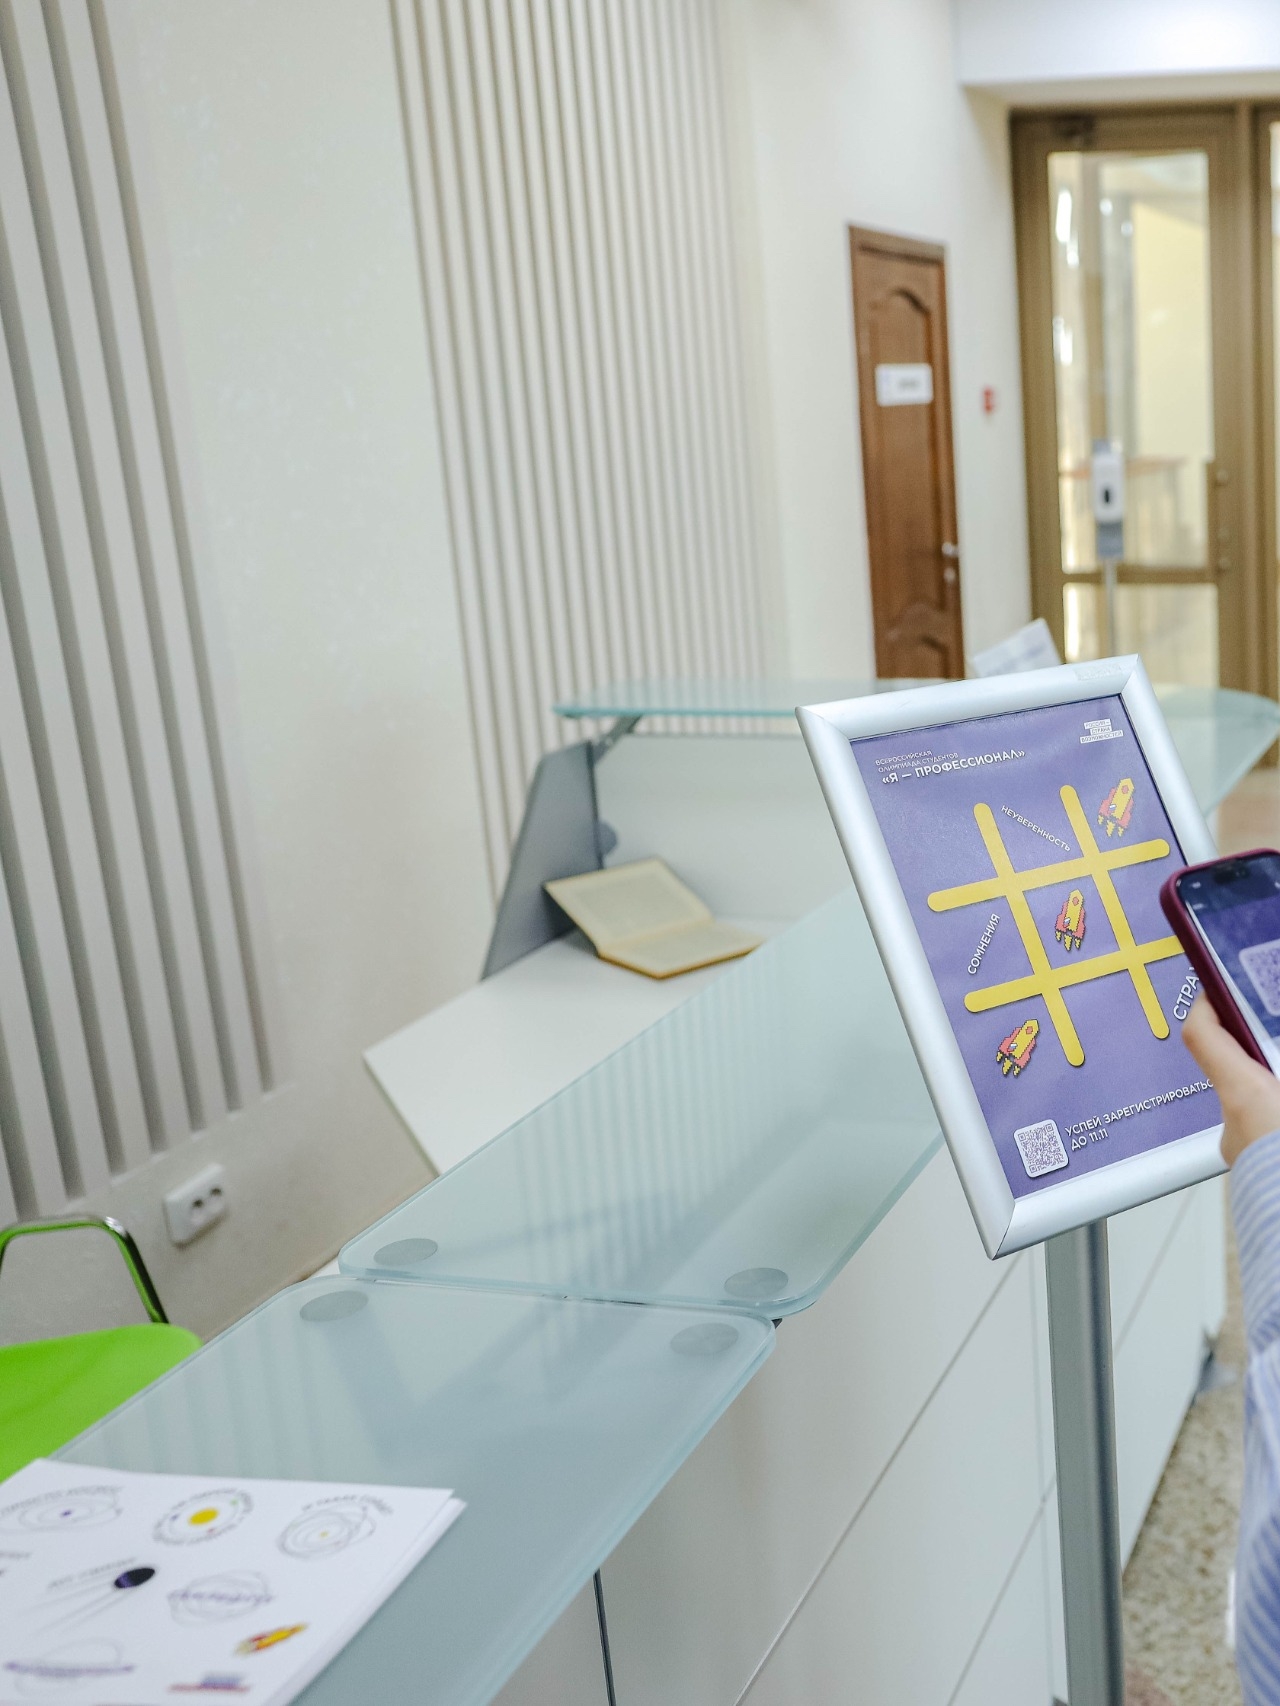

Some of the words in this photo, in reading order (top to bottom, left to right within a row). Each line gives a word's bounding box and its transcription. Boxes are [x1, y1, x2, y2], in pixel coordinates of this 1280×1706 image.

[875, 750, 933, 766] ВСЕРОССИЙСКАЯ
[878, 759, 921, 773] ОЛИМПИАДА
[922, 752, 959, 765] СТУДЕНТОВ
[882, 772, 899, 784] «Я
[914, 749, 1025, 778] ПРОФЕССИОНАЛ»
[1001, 804, 1071, 852] НЕУВЕРЕННОСТЬ
[967, 913, 1000, 974] СОМНЕНИЯ
[1173, 966, 1200, 1020] СТРА
[1065, 1115, 1102, 1136] УСПЕЙ
[1103, 1078, 1214, 1124] ЗАРЕГИСТРИРОВАТЬС
[1071, 1136, 1087, 1151] ДО
[1089, 1128, 1108, 1142] 11.11
